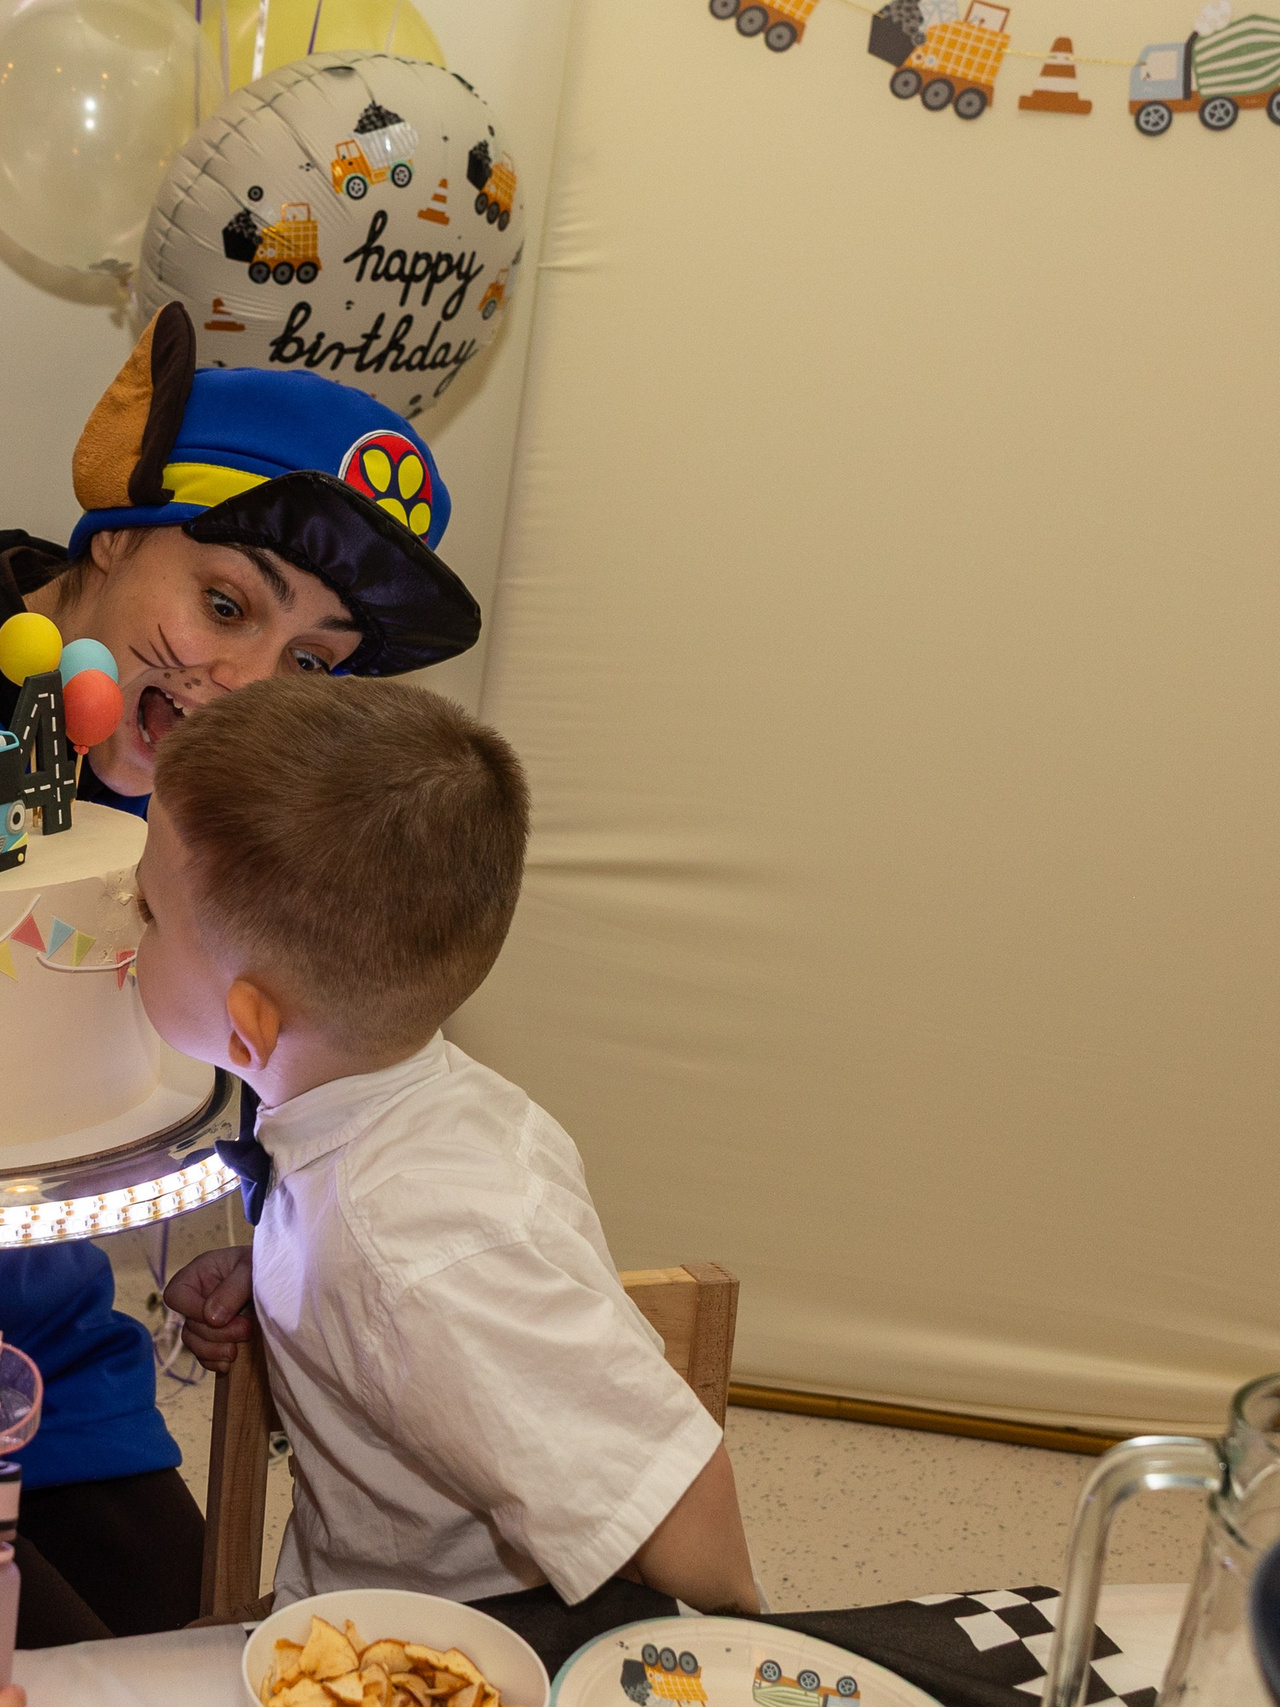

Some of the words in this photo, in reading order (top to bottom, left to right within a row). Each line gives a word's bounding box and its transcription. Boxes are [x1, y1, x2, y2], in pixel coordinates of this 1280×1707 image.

[344, 210, 483, 320] happy
[270, 301, 478, 397] birthday
[10, 669, 77, 835] 4
